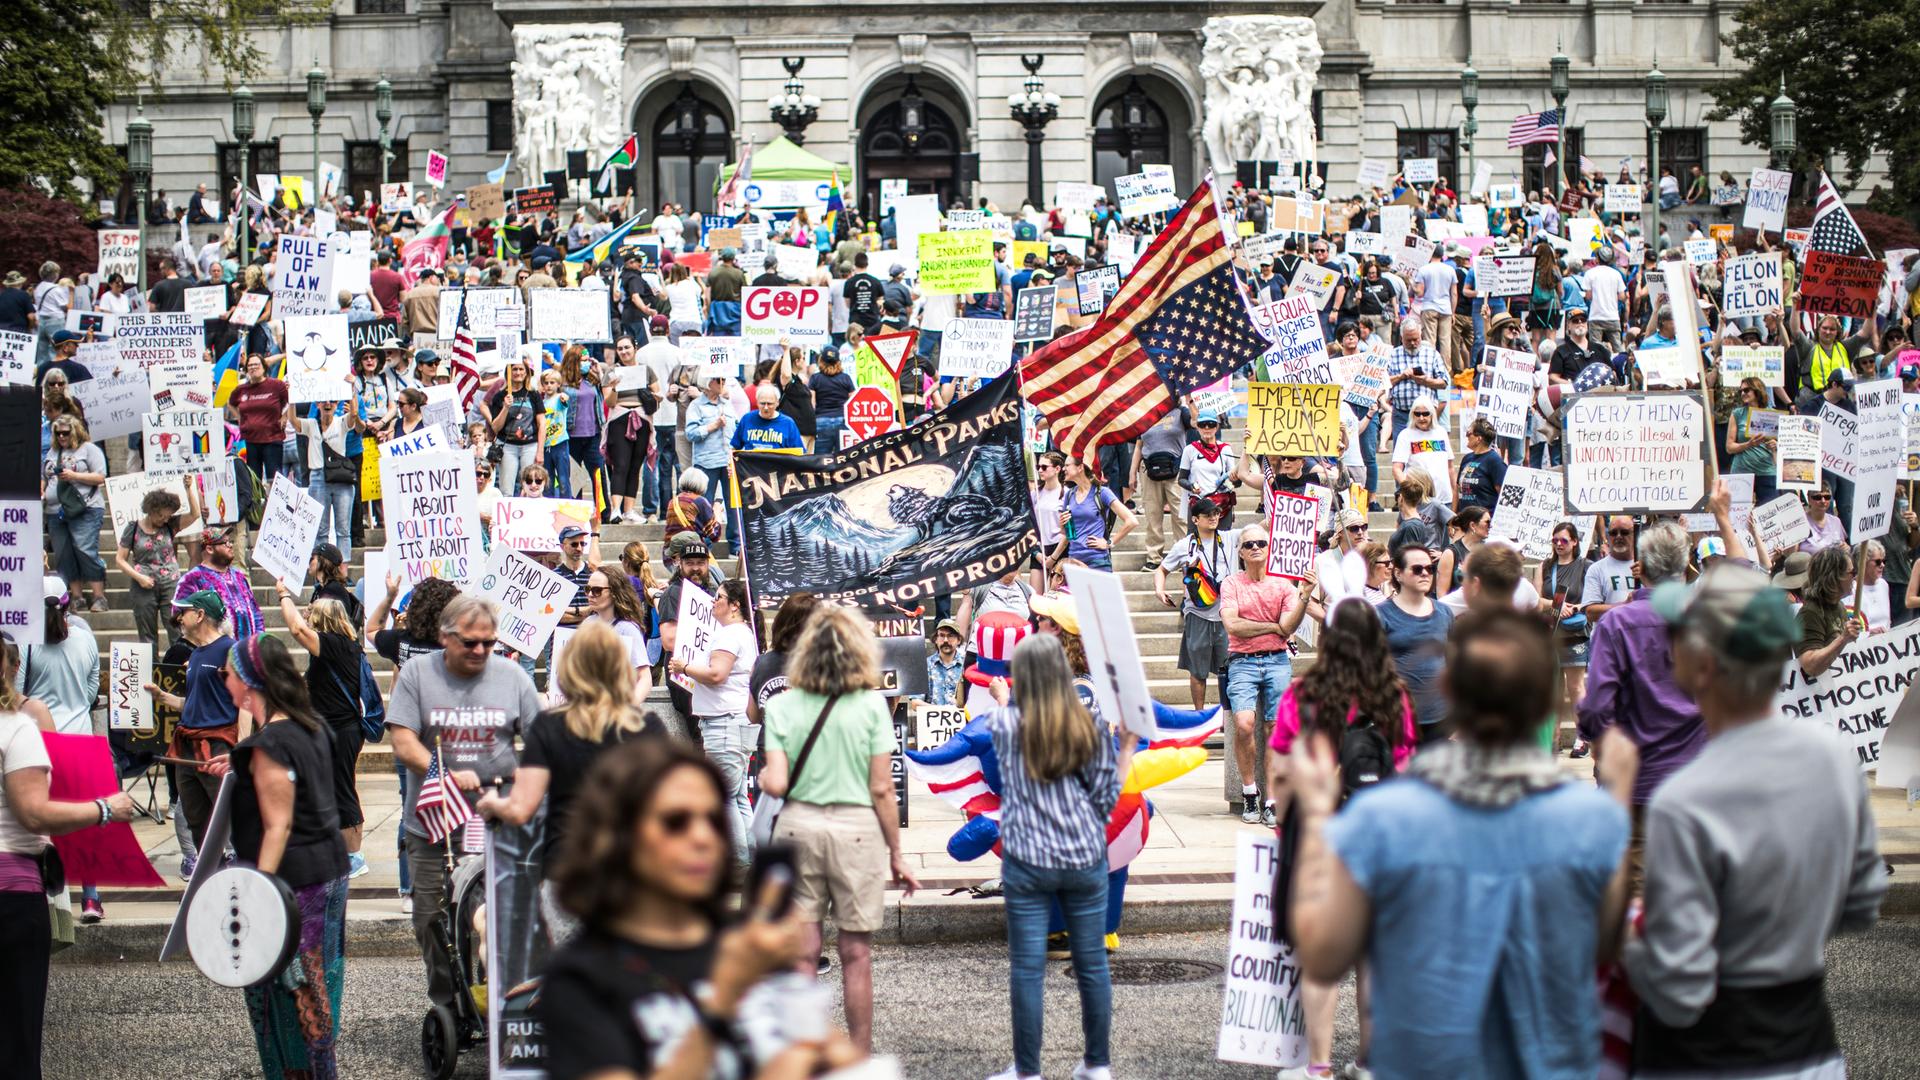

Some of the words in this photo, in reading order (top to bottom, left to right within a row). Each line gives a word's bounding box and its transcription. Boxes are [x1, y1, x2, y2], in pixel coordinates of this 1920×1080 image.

[1752, 171, 1789, 189] SAVE
[104, 234, 140, 246] STOP
[282, 239, 328, 258] RULE
[936, 245, 982, 258] INNOCENT
[292, 258, 314, 272] OF
[1816, 254, 1876, 269] CONSPIRING
[1302, 273, 1315, 284] This
[1726, 260, 1777, 284] FELON
[1812, 264, 1826, 274] TO
[1834, 266, 1884, 280] DISMANTLE
[286, 274, 320, 290] LAW
[1826, 277, 1882, 290] GOVERNMENT
[1835, 286, 1846, 296] IS
[1726, 288, 1779, 310] FELON
[1800, 294, 1876, 318] TREASON
[1272, 296, 1316, 323] EQUAL
[119, 316, 146, 326] THIS
[152, 316, 162, 324] IS
[166, 314, 192, 324] THE
[5, 332, 32, 342] KINGS
[118, 326, 204, 336] GOVERNMENT
[1282, 332, 1298, 348] OF
[6, 342, 24, 351] THE
[129, 338, 192, 348] FOUNDERS
[960, 340, 989, 352] TRUMP
[120, 350, 175, 360] WARNED
[182, 348, 197, 358] US
[1264, 338, 1324, 367] GOVERNMENT
[1366, 354, 1378, 364] OF
[1726, 350, 1782, 359] IMMIGRANTS
[10, 362, 23, 370] DO
[986, 360, 1008, 374] GOD
[1361, 364, 1384, 379] RAGE
[1746, 360, 1763, 368] ARE
[1354, 374, 1382, 389] CANNOT
[1734, 370, 1776, 379] AMERICA
[1496, 374, 1530, 395] DICTATOR
[1252, 386, 1341, 408] IMPEACH
[1493, 394, 1520, 415] DICK
[1858, 392, 1880, 409] HANDS
[1886, 388, 1900, 405] OFF!
[852, 401, 888, 416] STOP
[148, 414, 164, 428] WE
[1492, 416, 1524, 436] TRAITOR
[390, 432, 436, 456] MAKE
[824, 434, 904, 466] PROTECT
[912, 414, 948, 434] OUR
[1254, 430, 1330, 452] AGAIN
[1576, 428, 1601, 444] they
[1604, 428, 1620, 442] do
[1623, 428, 1634, 442] is
[1640, 426, 1677, 442] illegal
[1682, 426, 1690, 439] &
[742, 444, 923, 509] NATIONAL
[922, 400, 1019, 456] PARKS
[1410, 440, 1446, 454] PEACE
[1576, 446, 1694, 464] UNCONSTITUTIONAL
[1842, 438, 1854, 455] is
[397, 470, 424, 494] IT'S
[429, 468, 461, 492] NOT
[1530, 474, 1542, 490] The
[1587, 467, 1630, 482] HOLD
[1642, 467, 1684, 480] Them
[412, 494, 458, 517] ABOUT
[1276, 498, 1312, 516] STOP
[1526, 492, 1536, 508] the
[1538, 494, 1562, 514] People
[1868, 492, 1881, 508] OUR
[4, 508, 28, 523] FOR
[1518, 508, 1551, 529] Stronger
[1858, 512, 1886, 532] COUNTRY
[397, 516, 463, 540] POLITICS
[1274, 514, 1314, 537] TRUMP
[262, 517, 300, 566] Constitution
[397, 540, 424, 560] IT'S
[429, 537, 470, 558] ABOUT
[1272, 536, 1314, 558] DEPORT
[407, 556, 468, 582] MORALS
[876, 576, 936, 606] NOT
[946, 529, 1040, 588] PROFITS.
[1270, 555, 1313, 576] MUSK
[500, 554, 542, 590] STAND
[540, 578, 562, 600] UP
[502, 585, 528, 610] FOR
[829, 585, 879, 599] DOGE
[500, 612, 537, 646] OTHER
[694, 626, 710, 652] BE
[1829, 646, 1890, 678] STAND
[130, 649, 140, 699] SCIENTIST
[118, 658, 131, 710] MAD
[130, 708, 140, 727] MAD
[430, 710, 506, 727] HARRIS
[440, 728, 496, 742] WALZ
[456, 754, 478, 762] 2024
[1230, 952, 1301, 1000] country
